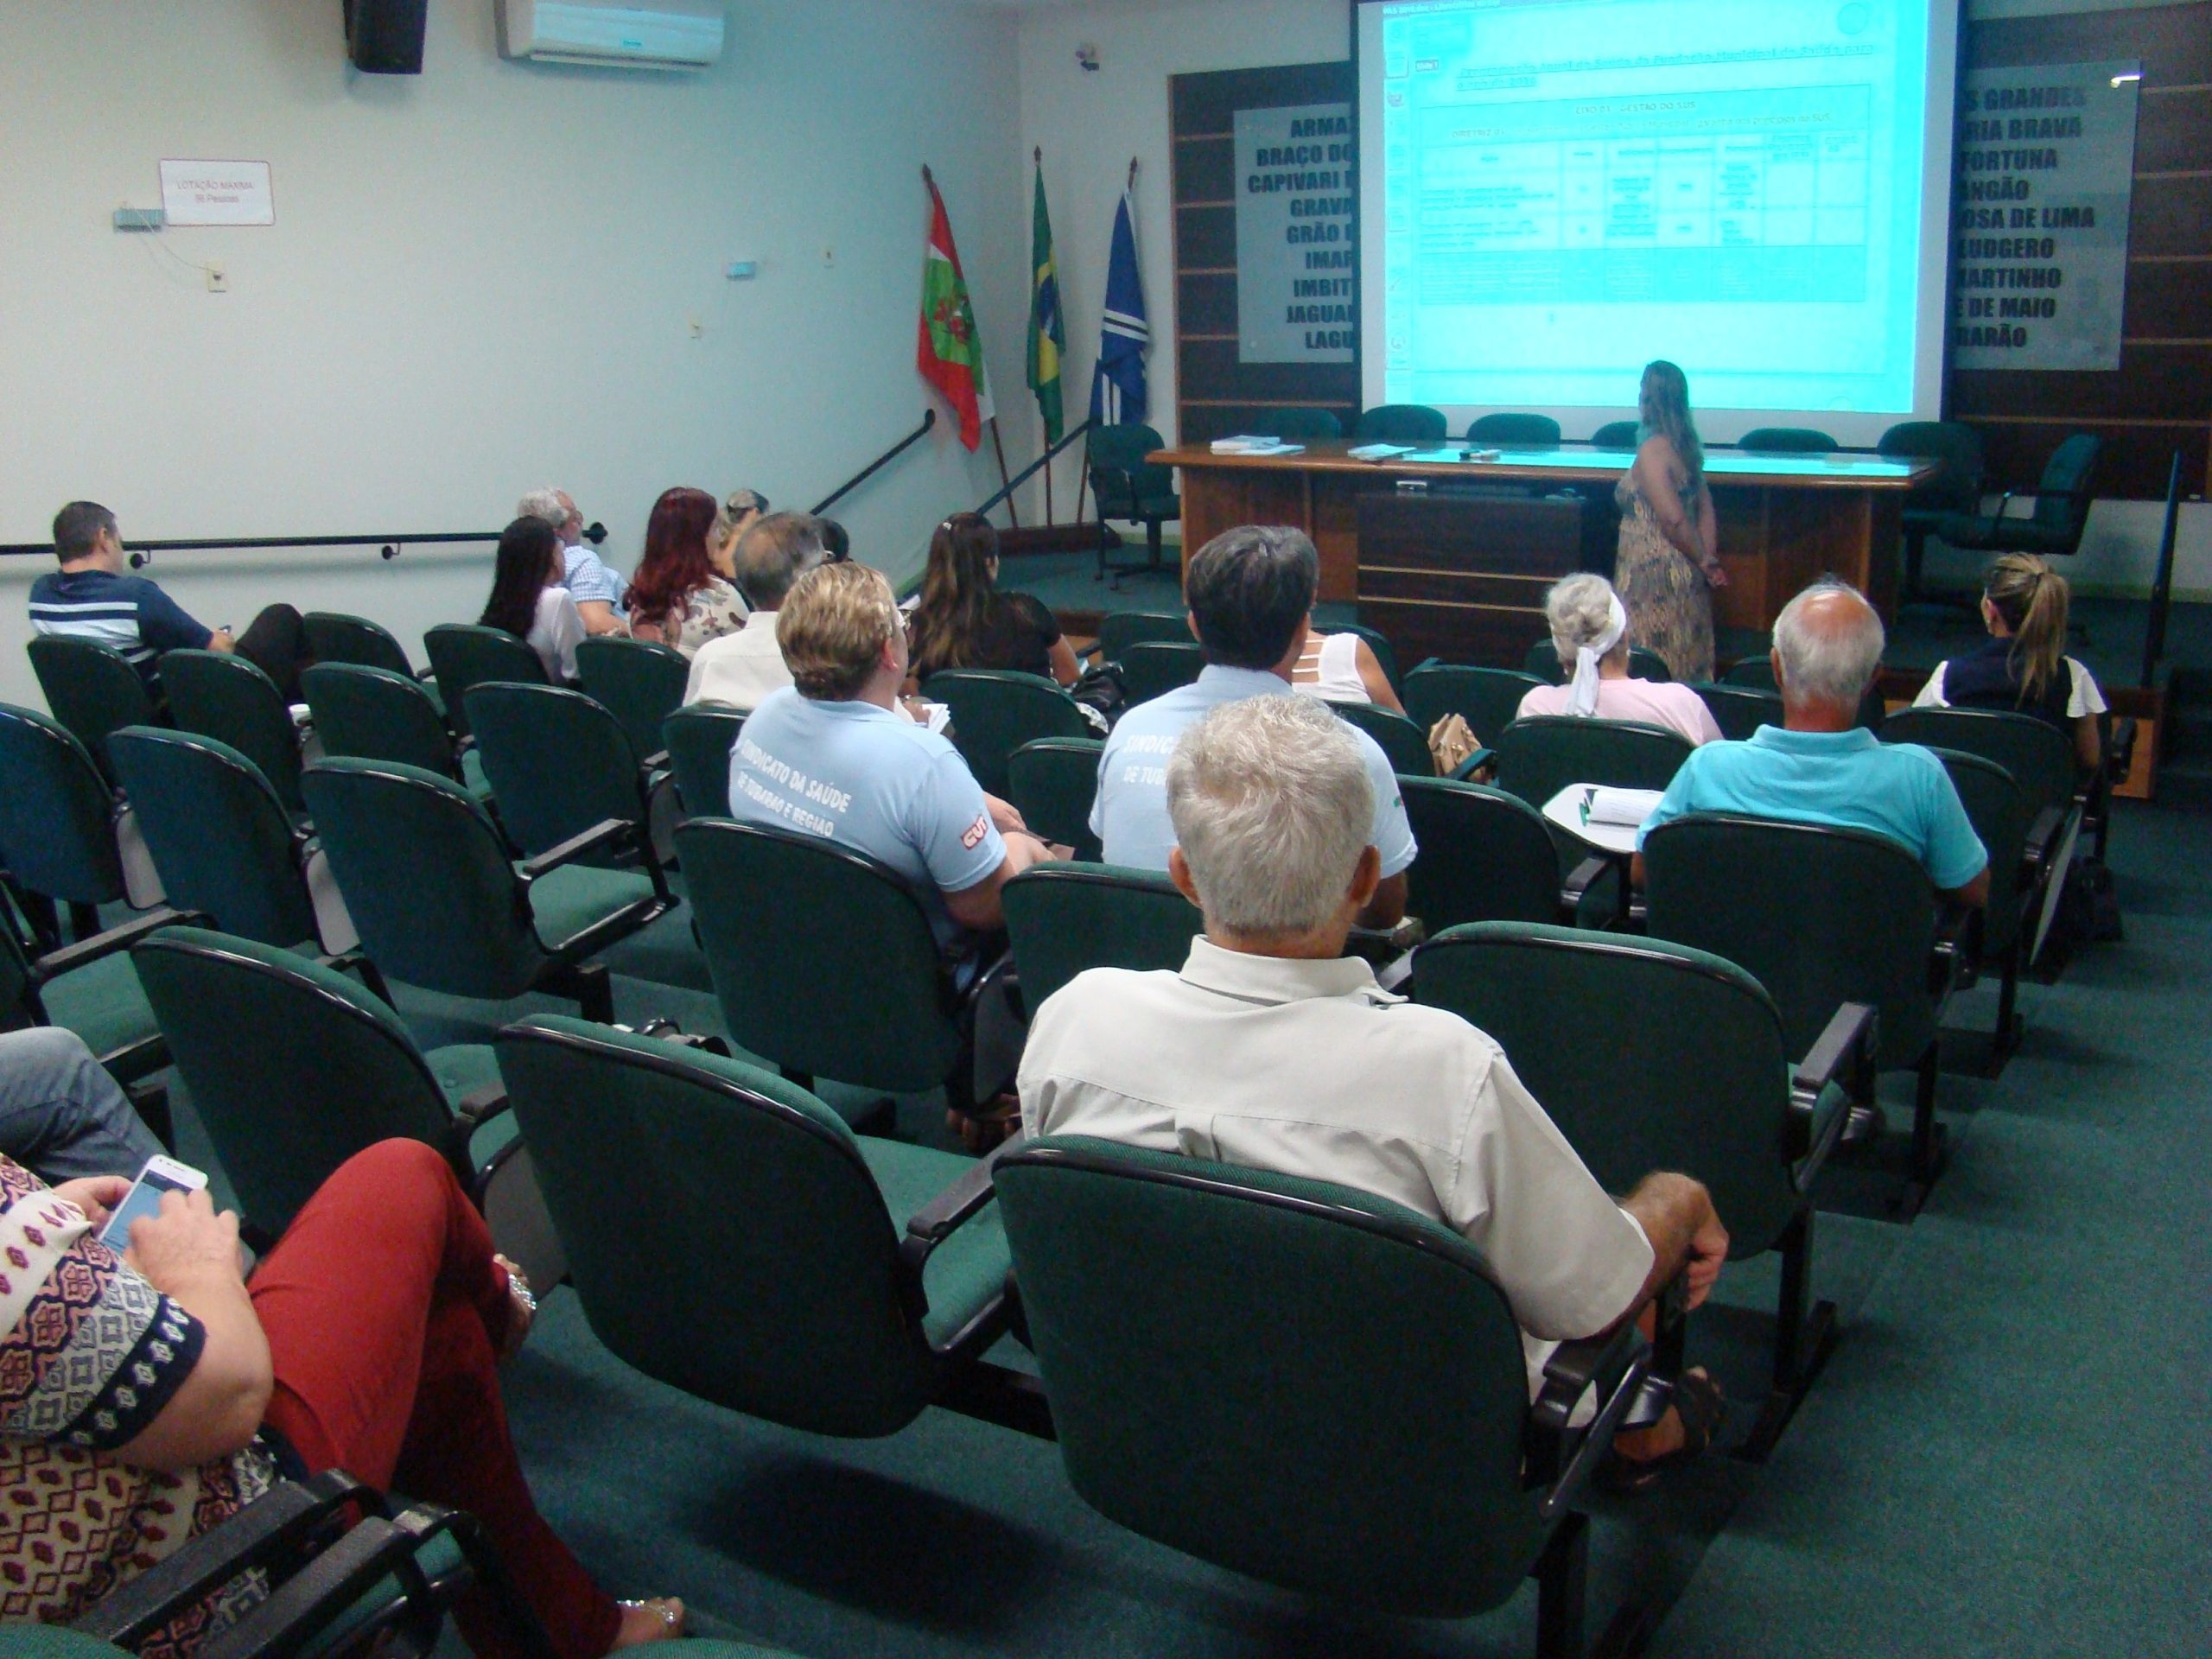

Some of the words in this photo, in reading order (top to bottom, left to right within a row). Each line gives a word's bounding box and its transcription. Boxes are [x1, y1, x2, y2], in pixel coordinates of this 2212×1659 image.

[2008, 115, 2082, 140] BRAVA
[1255, 144, 1323, 168] BRAÇO
[1247, 170, 1339, 193] CAPIVARI
[2010, 207, 2037, 229] DE
[2042, 207, 2096, 229] LIMA
[1286, 221, 1340, 245] GRÃO
[1293, 277, 1352, 297] IMBIT
[1968, 297, 1995, 318] DE
[1999, 296, 2056, 318] MAIO
[1122, 734, 1175, 755] SINDIC
[1122, 765, 1141, 784] DE
[1140, 766, 1167, 785] TUB
[788, 770, 808, 794] DA
[805, 779, 853, 814] SAÚDE
[782, 802, 794, 819] E
[791, 804, 836, 838] REGIÃO
[963, 815, 988, 848] CUT
